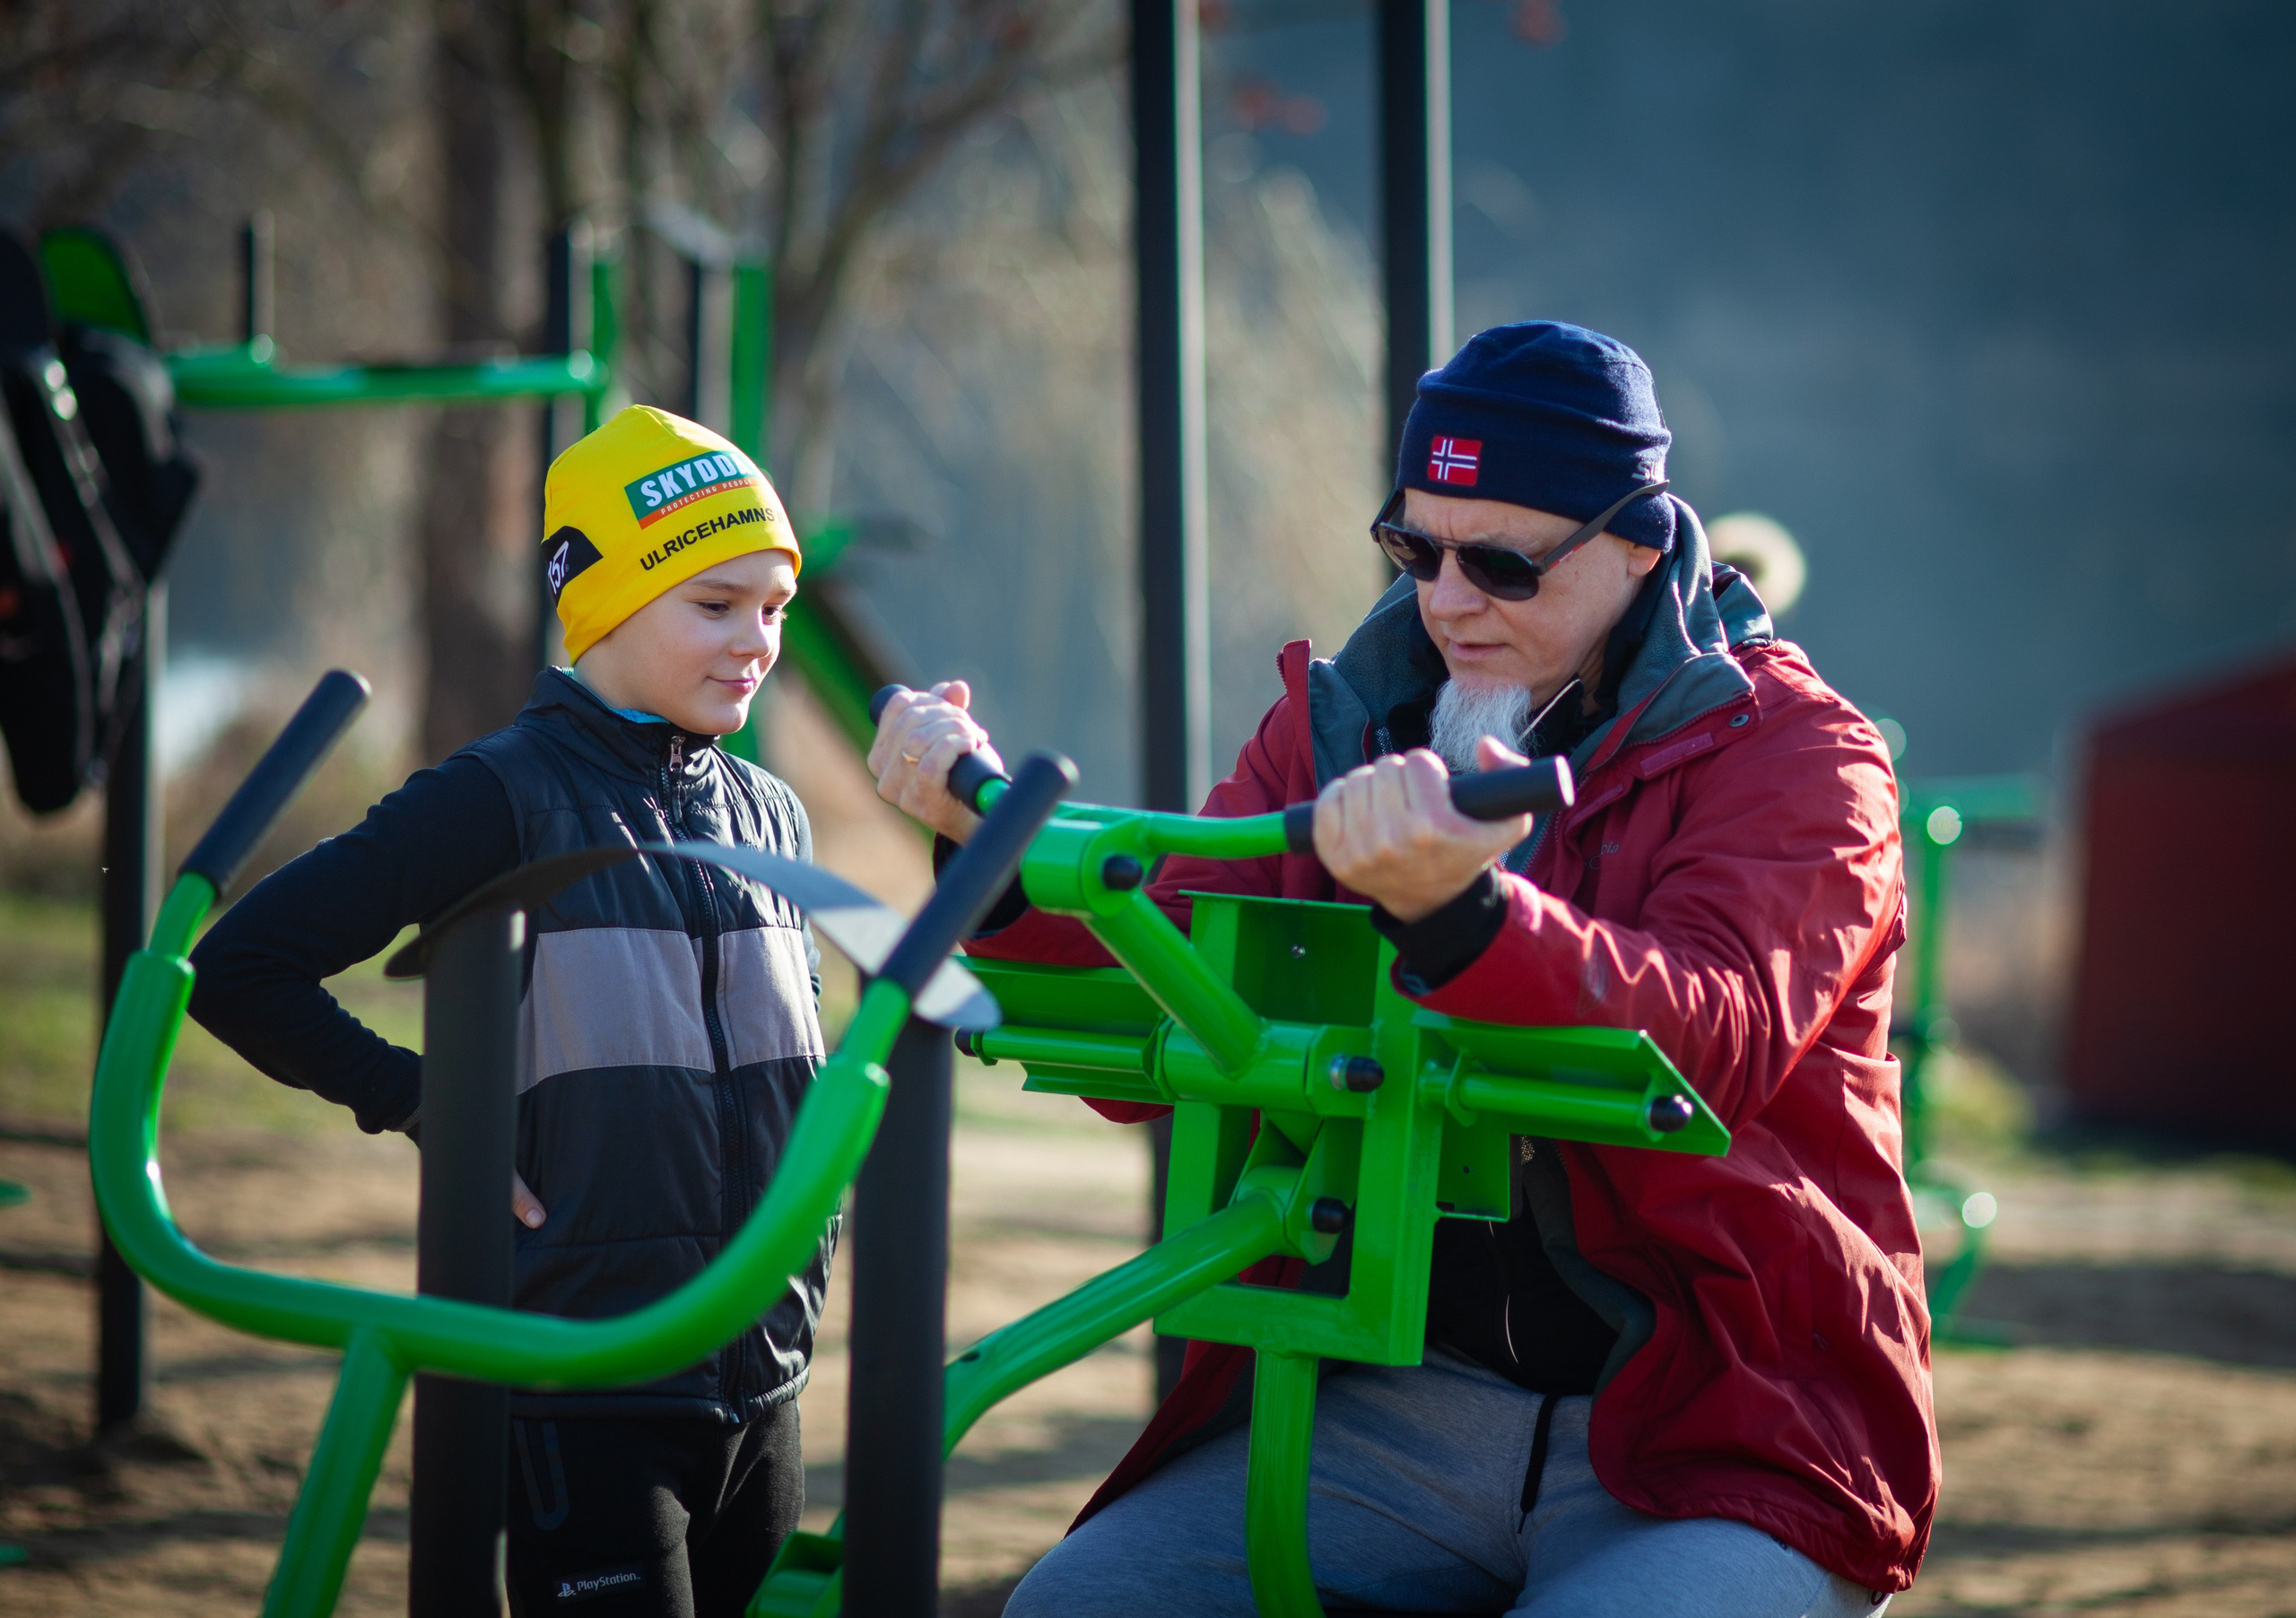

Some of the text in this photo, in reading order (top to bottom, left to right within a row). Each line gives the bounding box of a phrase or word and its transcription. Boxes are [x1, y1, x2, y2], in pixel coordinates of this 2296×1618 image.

[640, 453, 753, 508] SKYDDA
[660, 477, 753, 516] PROTECTING PEOPLE
[639, 507, 775, 571] ULRICEHAMNS
[577, 1572, 637, 1592] PlayStation
